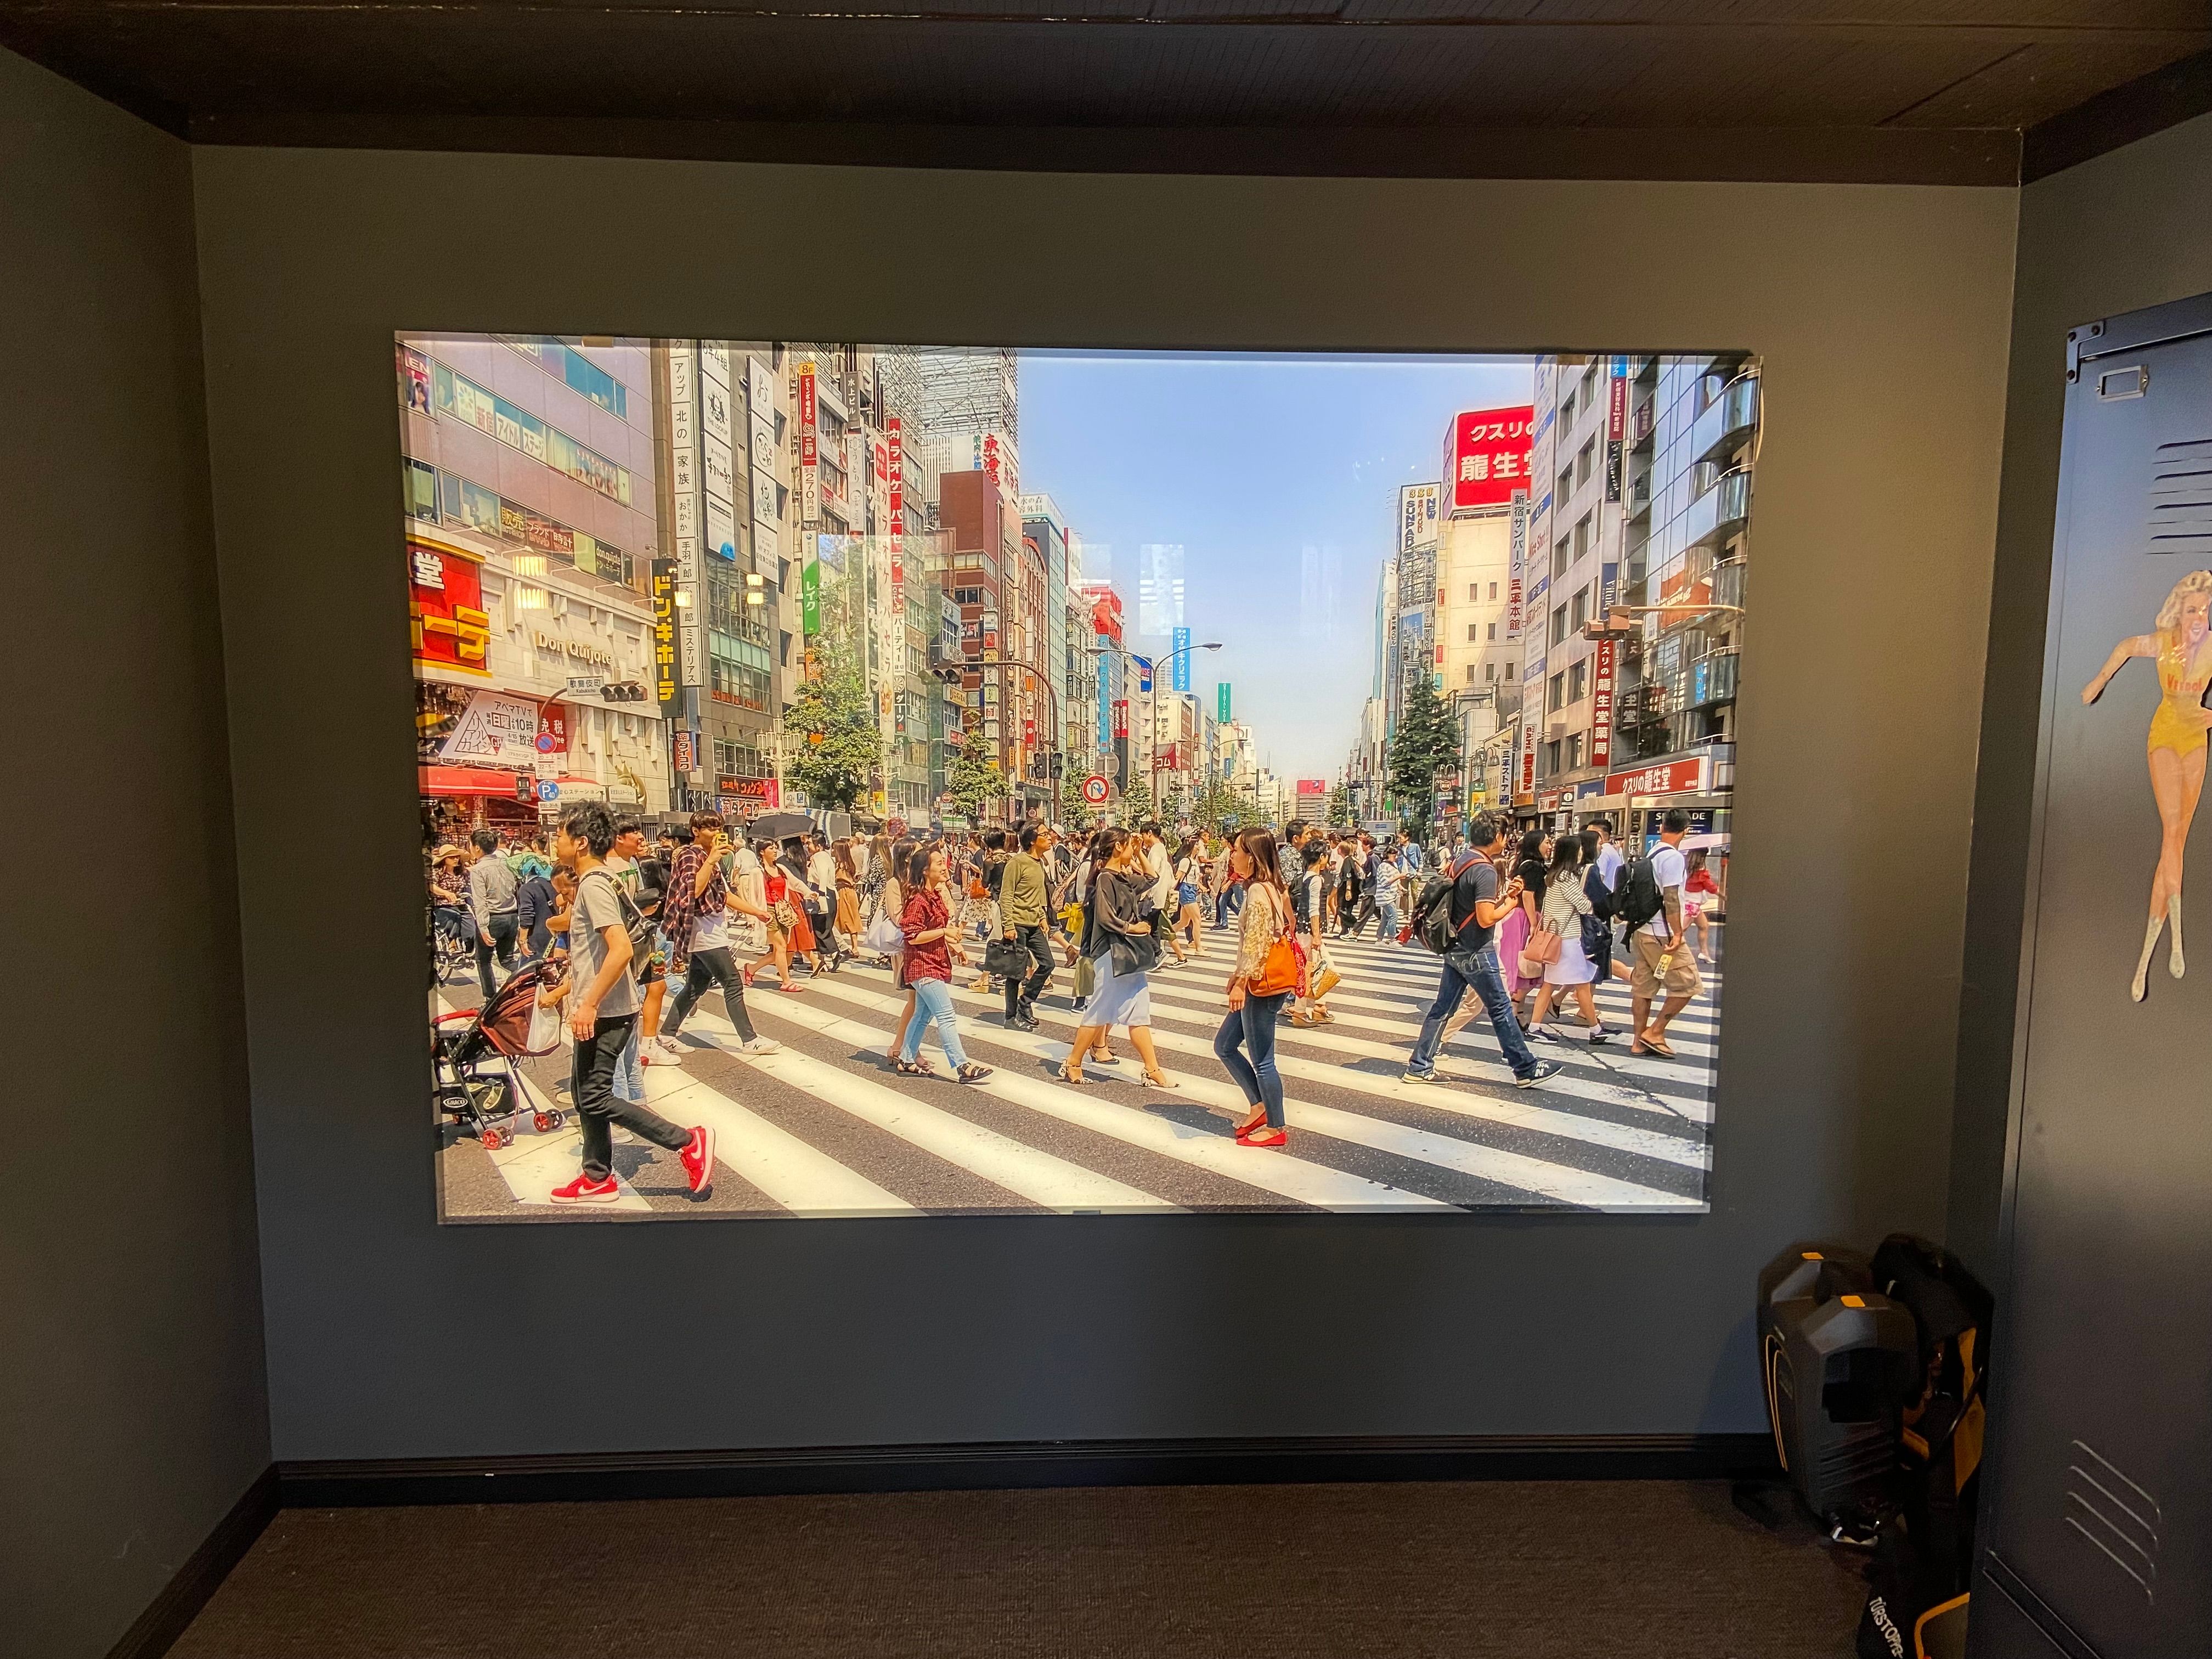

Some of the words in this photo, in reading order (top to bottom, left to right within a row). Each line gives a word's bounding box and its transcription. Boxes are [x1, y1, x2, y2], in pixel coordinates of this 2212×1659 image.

[802, 365, 813, 374] 8F
[848, 379, 856, 415] 水上ビル
[676, 410, 690, 485] 北の家族
[501, 506, 524, 532] 販売
[679, 501, 687, 532] おかか
[1426, 498, 1436, 520] NEW
[553, 532, 573, 548] 時計
[1511, 494, 1525, 572] 新宿サンパーク
[414, 552, 445, 590] 堂
[681, 541, 692, 578] 手羽一郎
[806, 581, 816, 611] レイク
[1509, 579, 1522, 631] 三平本館
[536, 631, 566, 653] Don
[653, 576, 675, 701] ドン・キホーテ
[894, 619, 902, 662] パーティー
[685, 628, 697, 684] ミステリアス
[570, 679, 601, 687] 歌舞伎町
[896, 695, 905, 723] ダーツ
[493, 713, 510, 729] 日曜
[516, 718, 534, 733] 10時
[541, 718, 564, 734] 免税
[460, 738, 493, 753] カイジ
[490, 737, 502, 748] GP
[519, 733, 535, 748] 放送
[1501, 751, 1510, 792] 三平ストア
[1622, 767, 1672, 794] クスリの龍生堂
[541, 785, 551, 798] P
[1180, 798, 1186, 806] P
